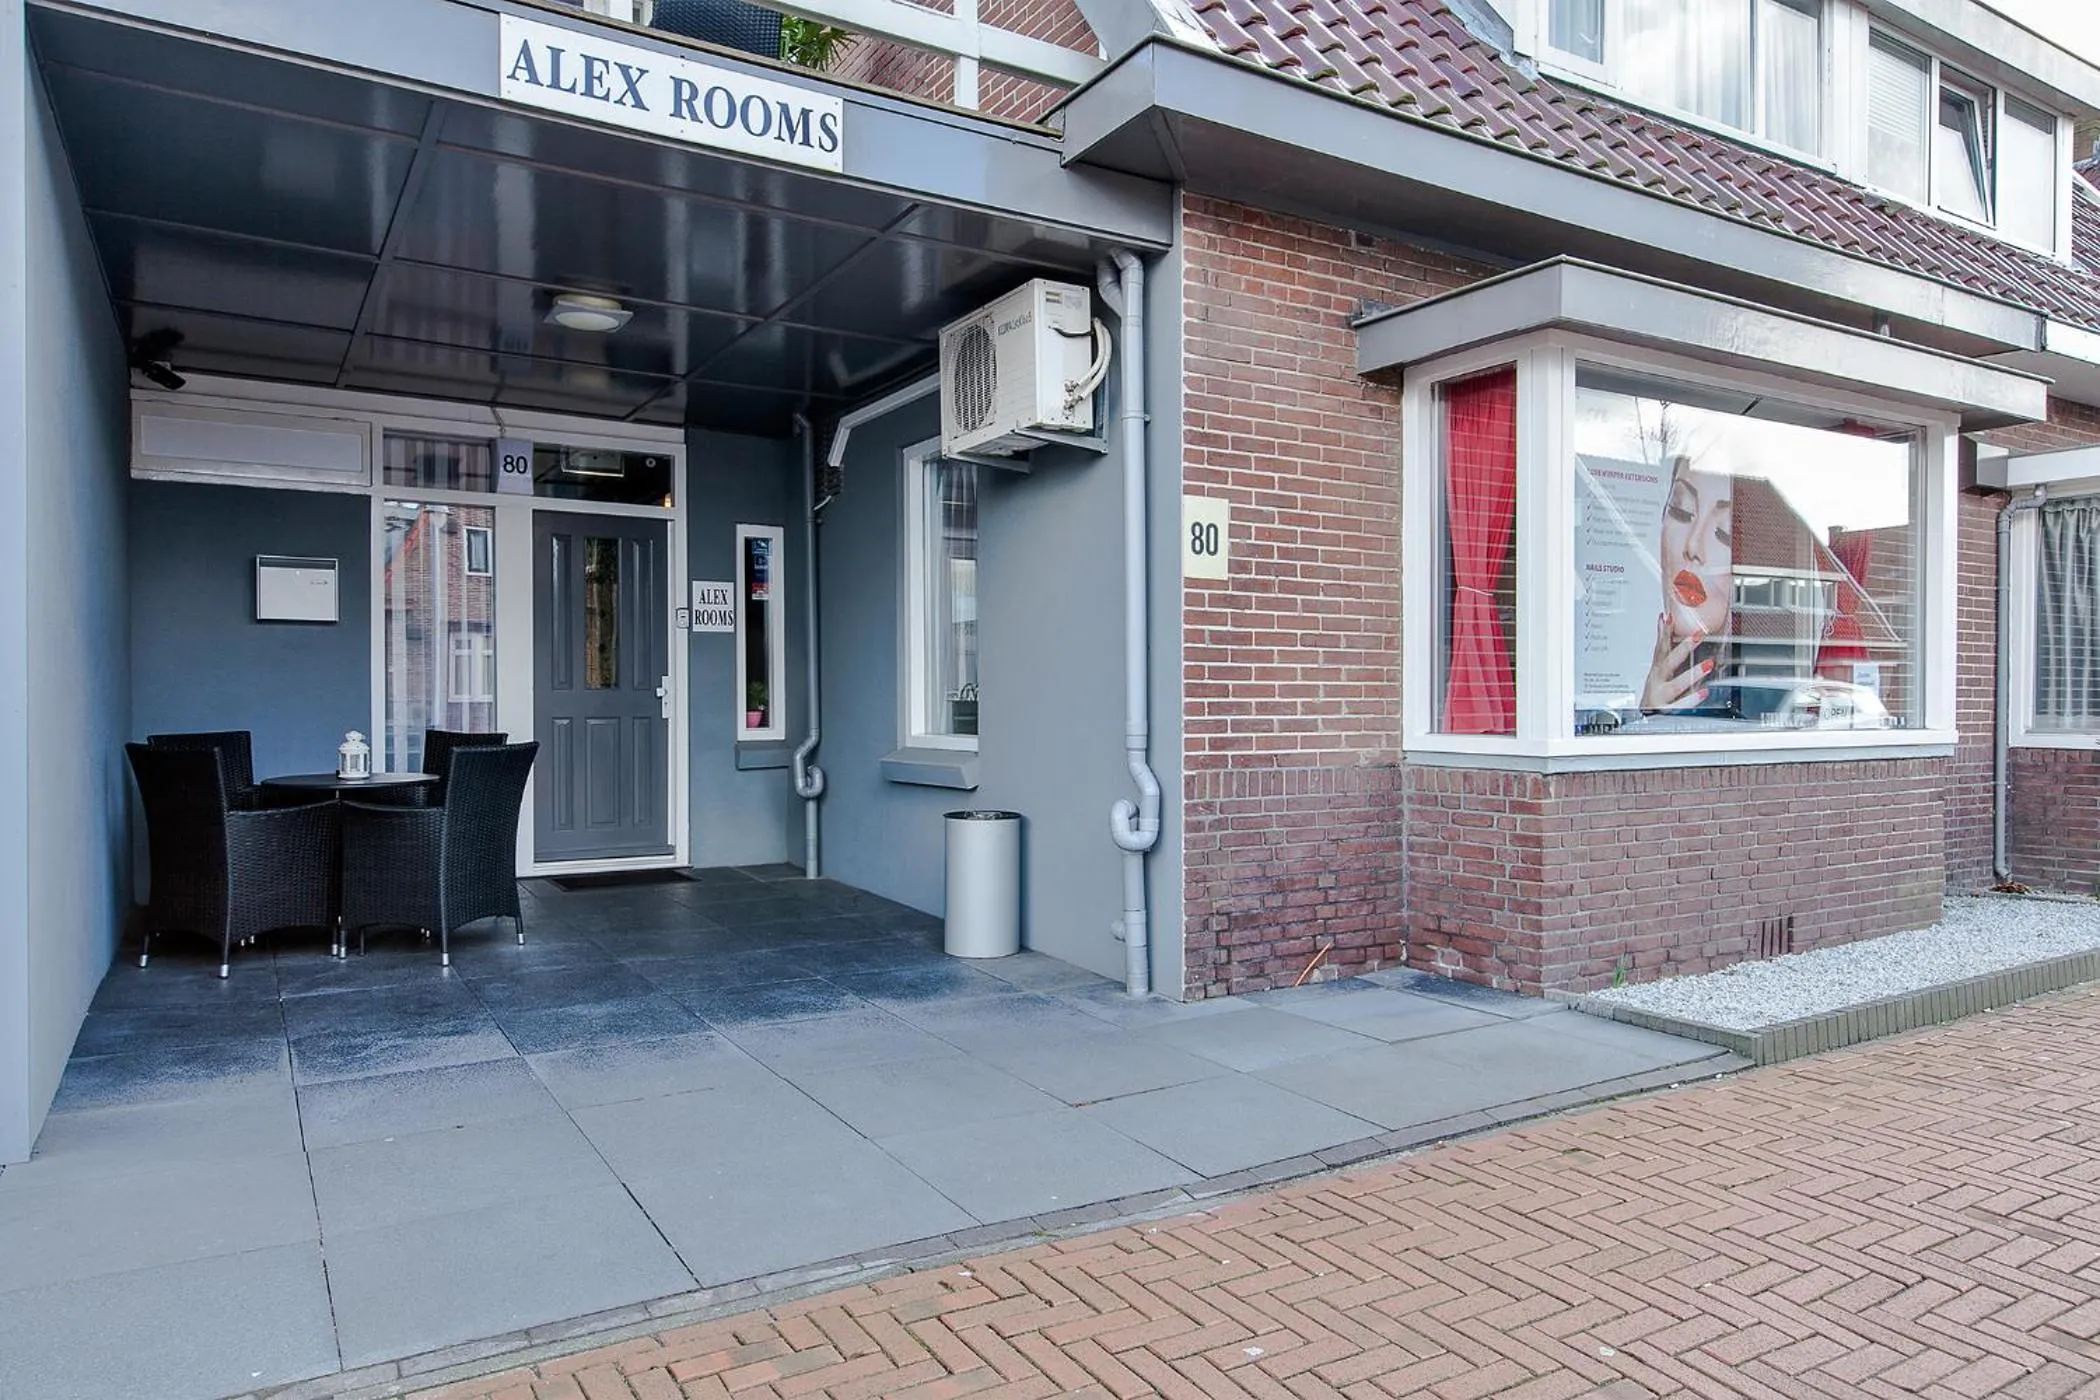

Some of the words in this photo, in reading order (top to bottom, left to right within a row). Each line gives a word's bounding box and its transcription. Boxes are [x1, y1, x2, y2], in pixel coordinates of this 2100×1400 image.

[506, 38, 651, 112] ALEX
[669, 74, 839, 154] ROOMS
[503, 454, 528, 475] 80
[1191, 521, 1219, 557] 80
[1586, 563, 1602, 572] NAILS
[1603, 565, 1625, 573] STUDIO
[698, 588, 729, 606] ALEX
[694, 608, 734, 627] ROOMS
